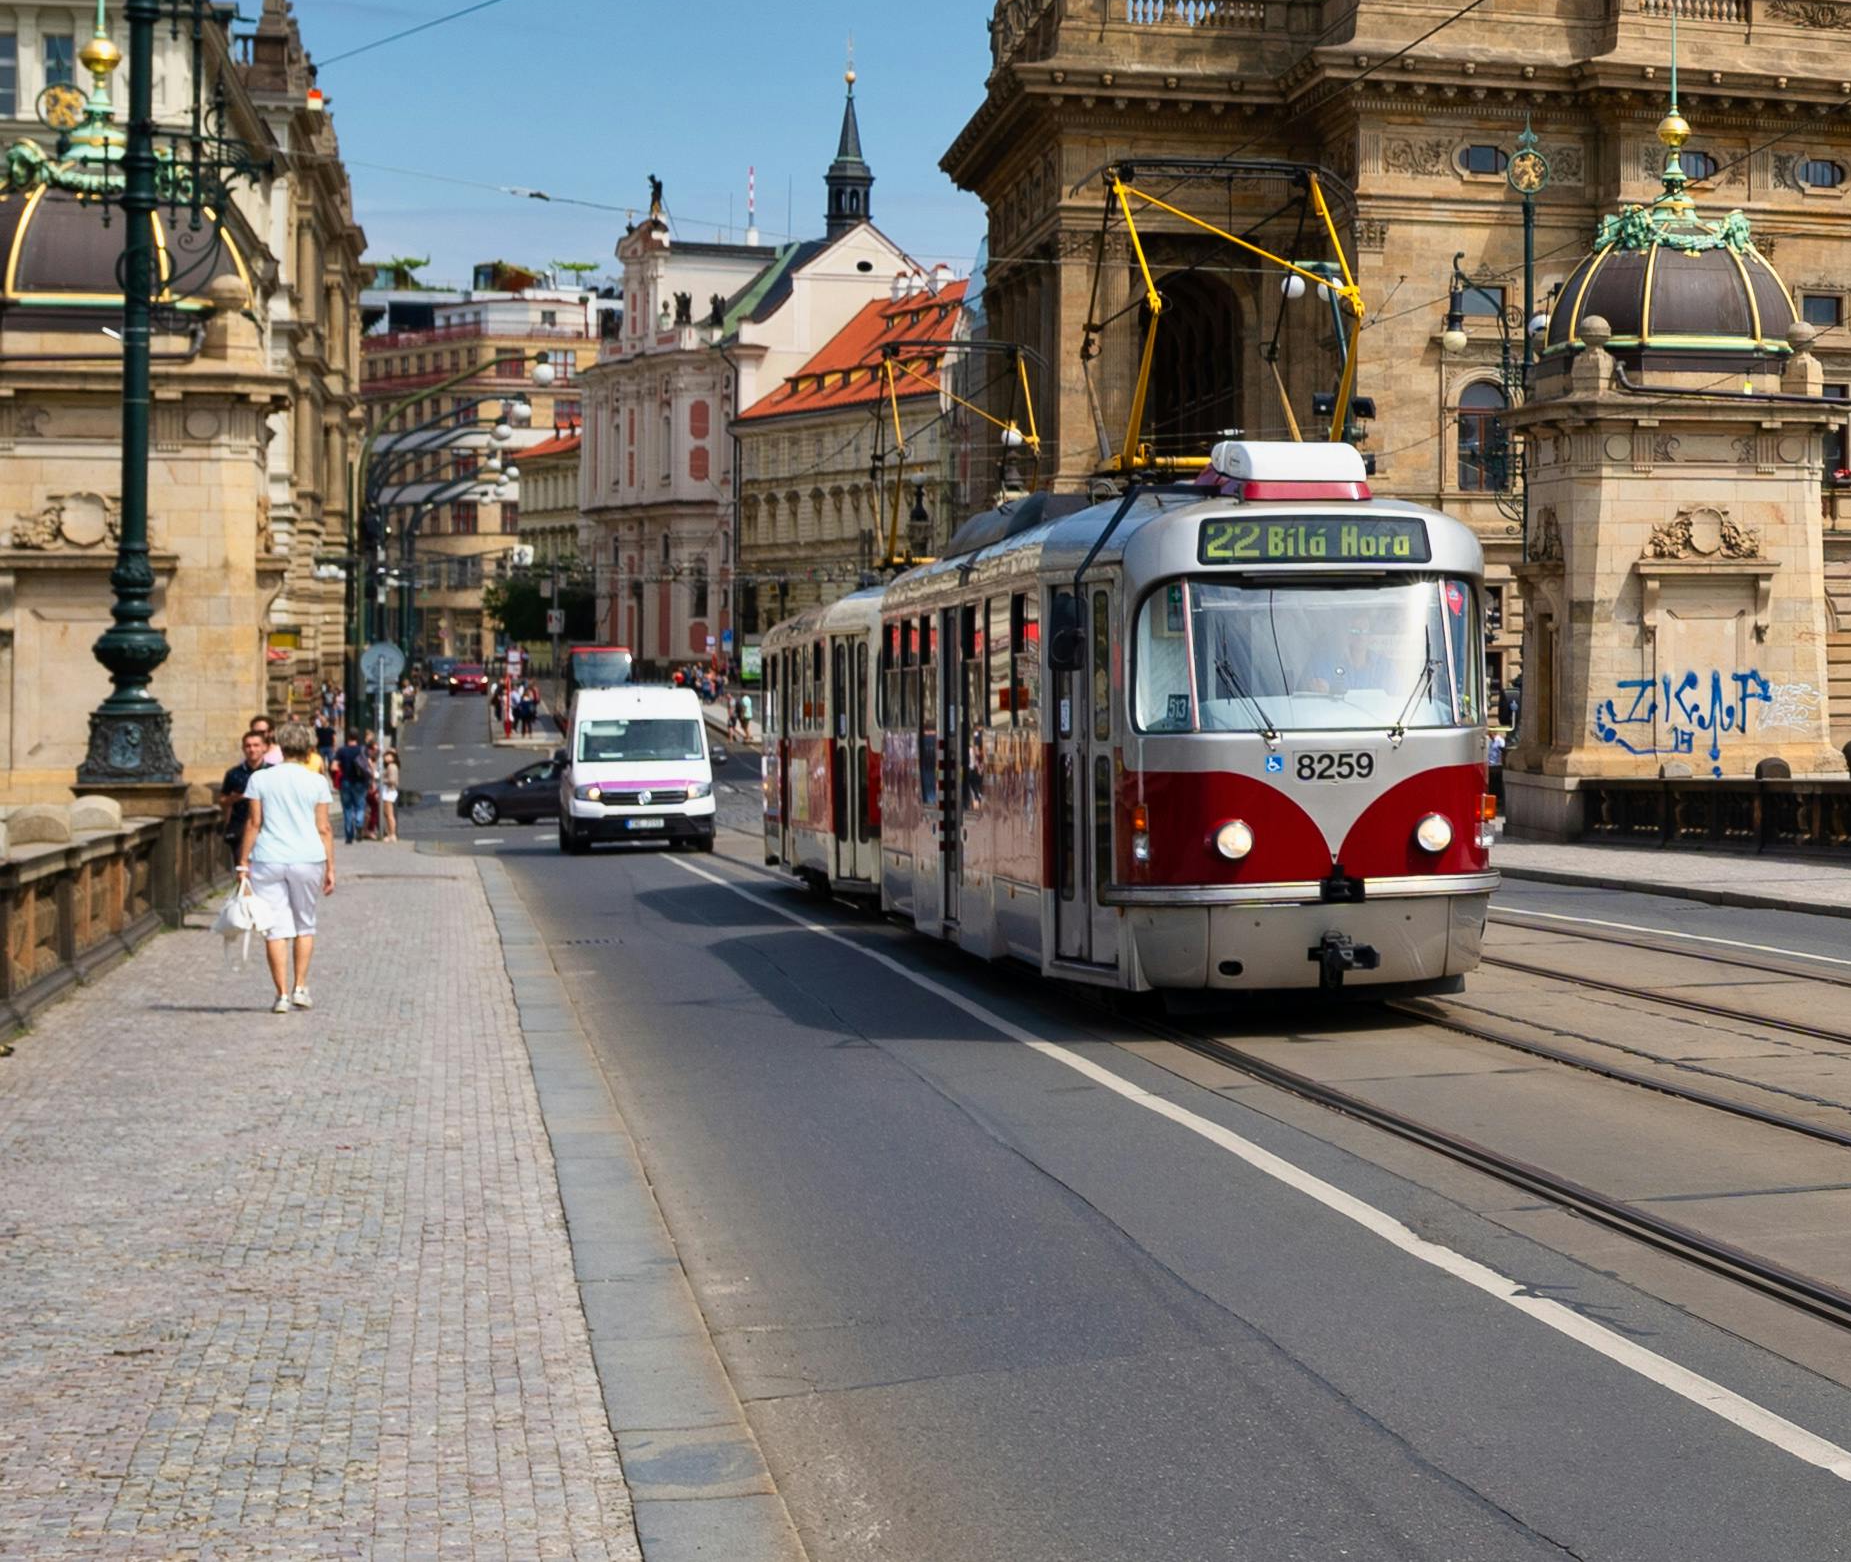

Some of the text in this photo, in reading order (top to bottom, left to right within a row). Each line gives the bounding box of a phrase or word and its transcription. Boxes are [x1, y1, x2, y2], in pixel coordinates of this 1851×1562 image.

[1207, 523, 1410, 558] 22 Bílá Hora
[1168, 698, 1187, 719] 513
[1296, 752, 1374, 781] 8259
